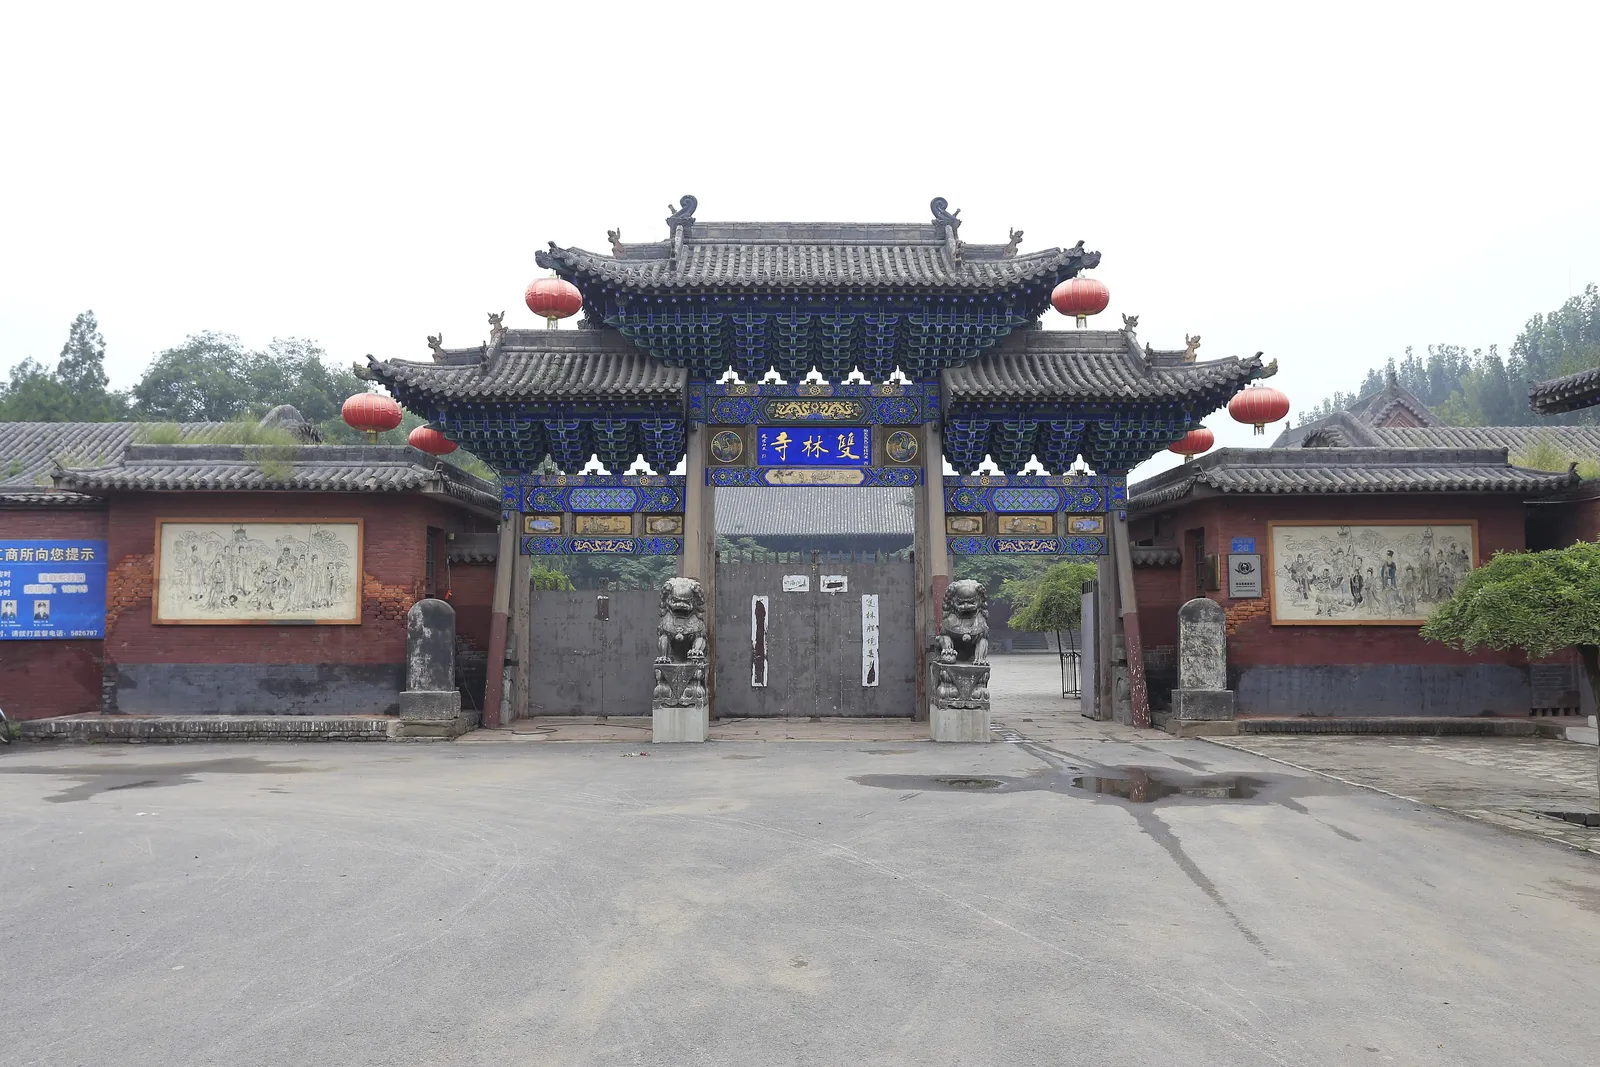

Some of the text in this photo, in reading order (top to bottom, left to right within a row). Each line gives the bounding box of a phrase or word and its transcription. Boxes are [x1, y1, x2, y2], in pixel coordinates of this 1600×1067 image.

[0, 548, 94, 561] 商所向您提示
